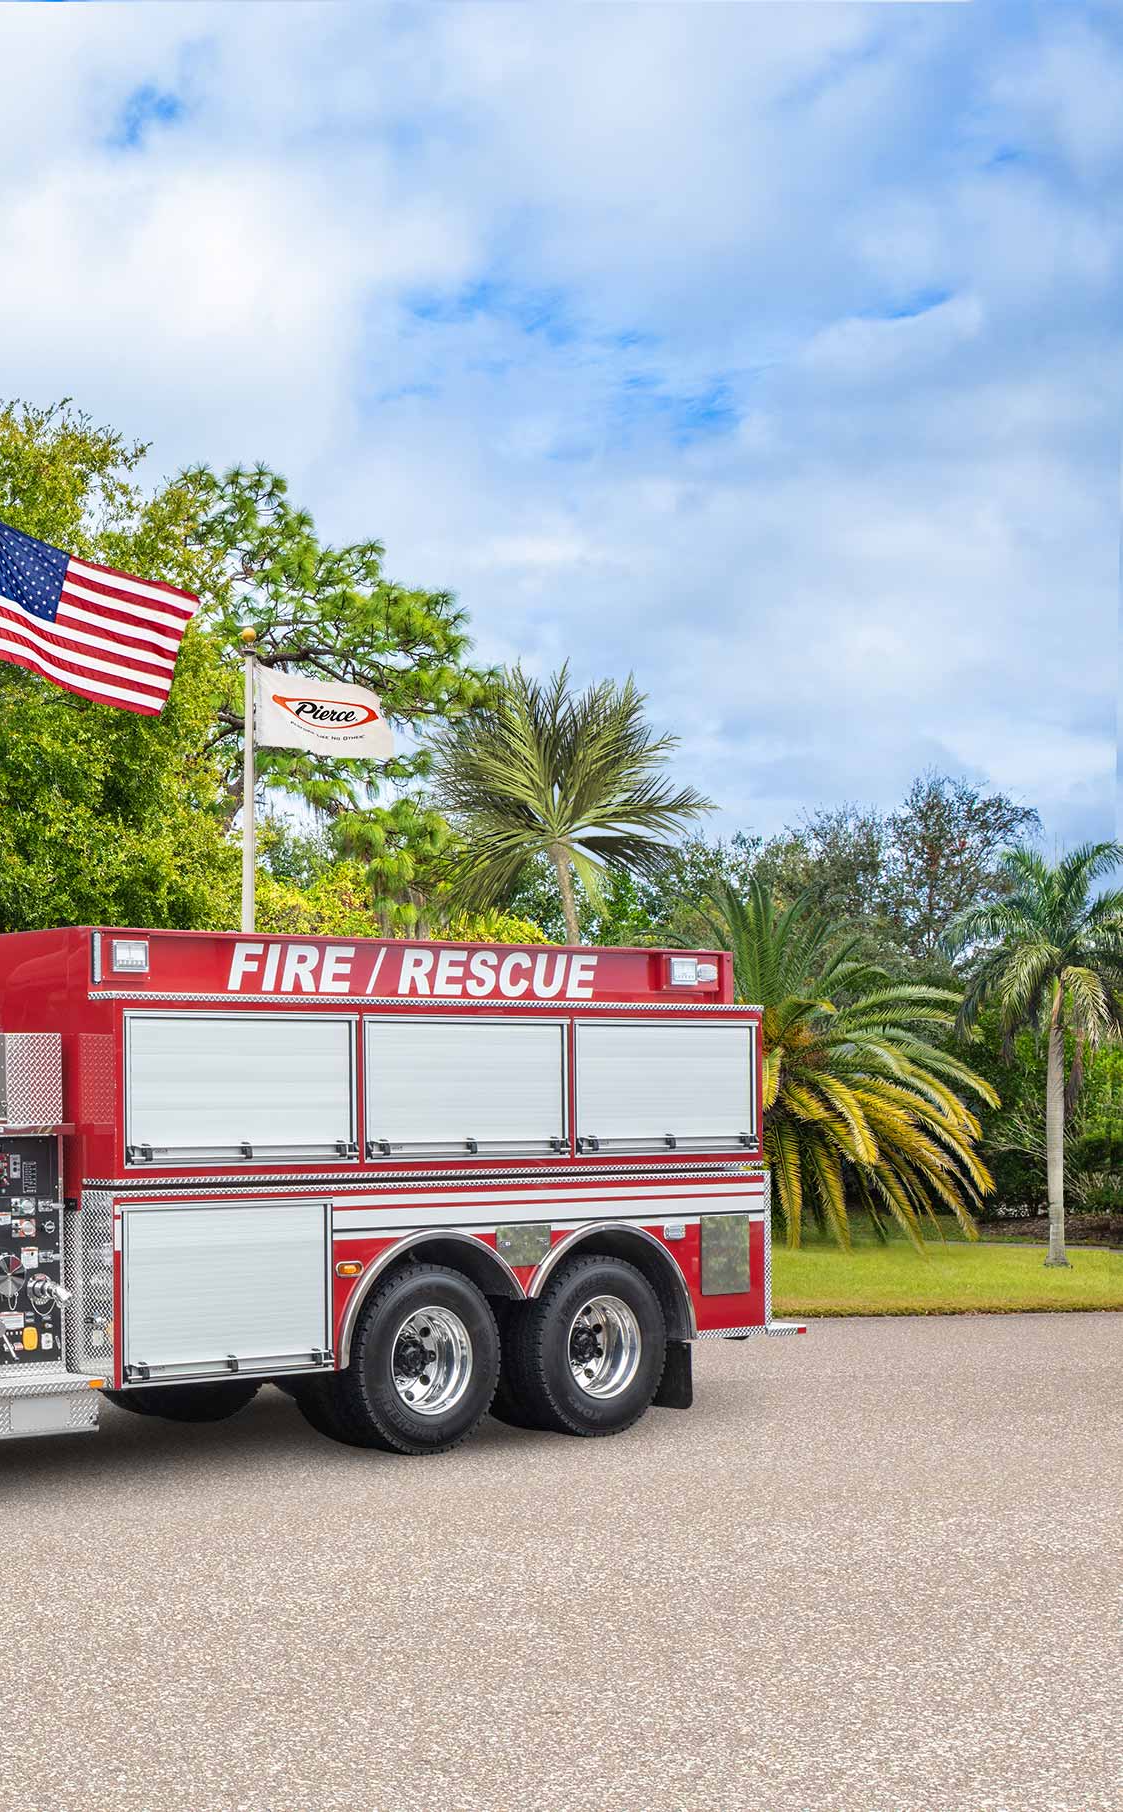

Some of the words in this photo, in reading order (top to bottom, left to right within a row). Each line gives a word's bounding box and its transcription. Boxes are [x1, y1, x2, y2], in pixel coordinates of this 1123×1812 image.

[295, 701, 356, 722] Pierce
[227, 942, 356, 993] FIRE
[365, 947, 387, 994] /
[397, 948, 598, 998] RESCUE
